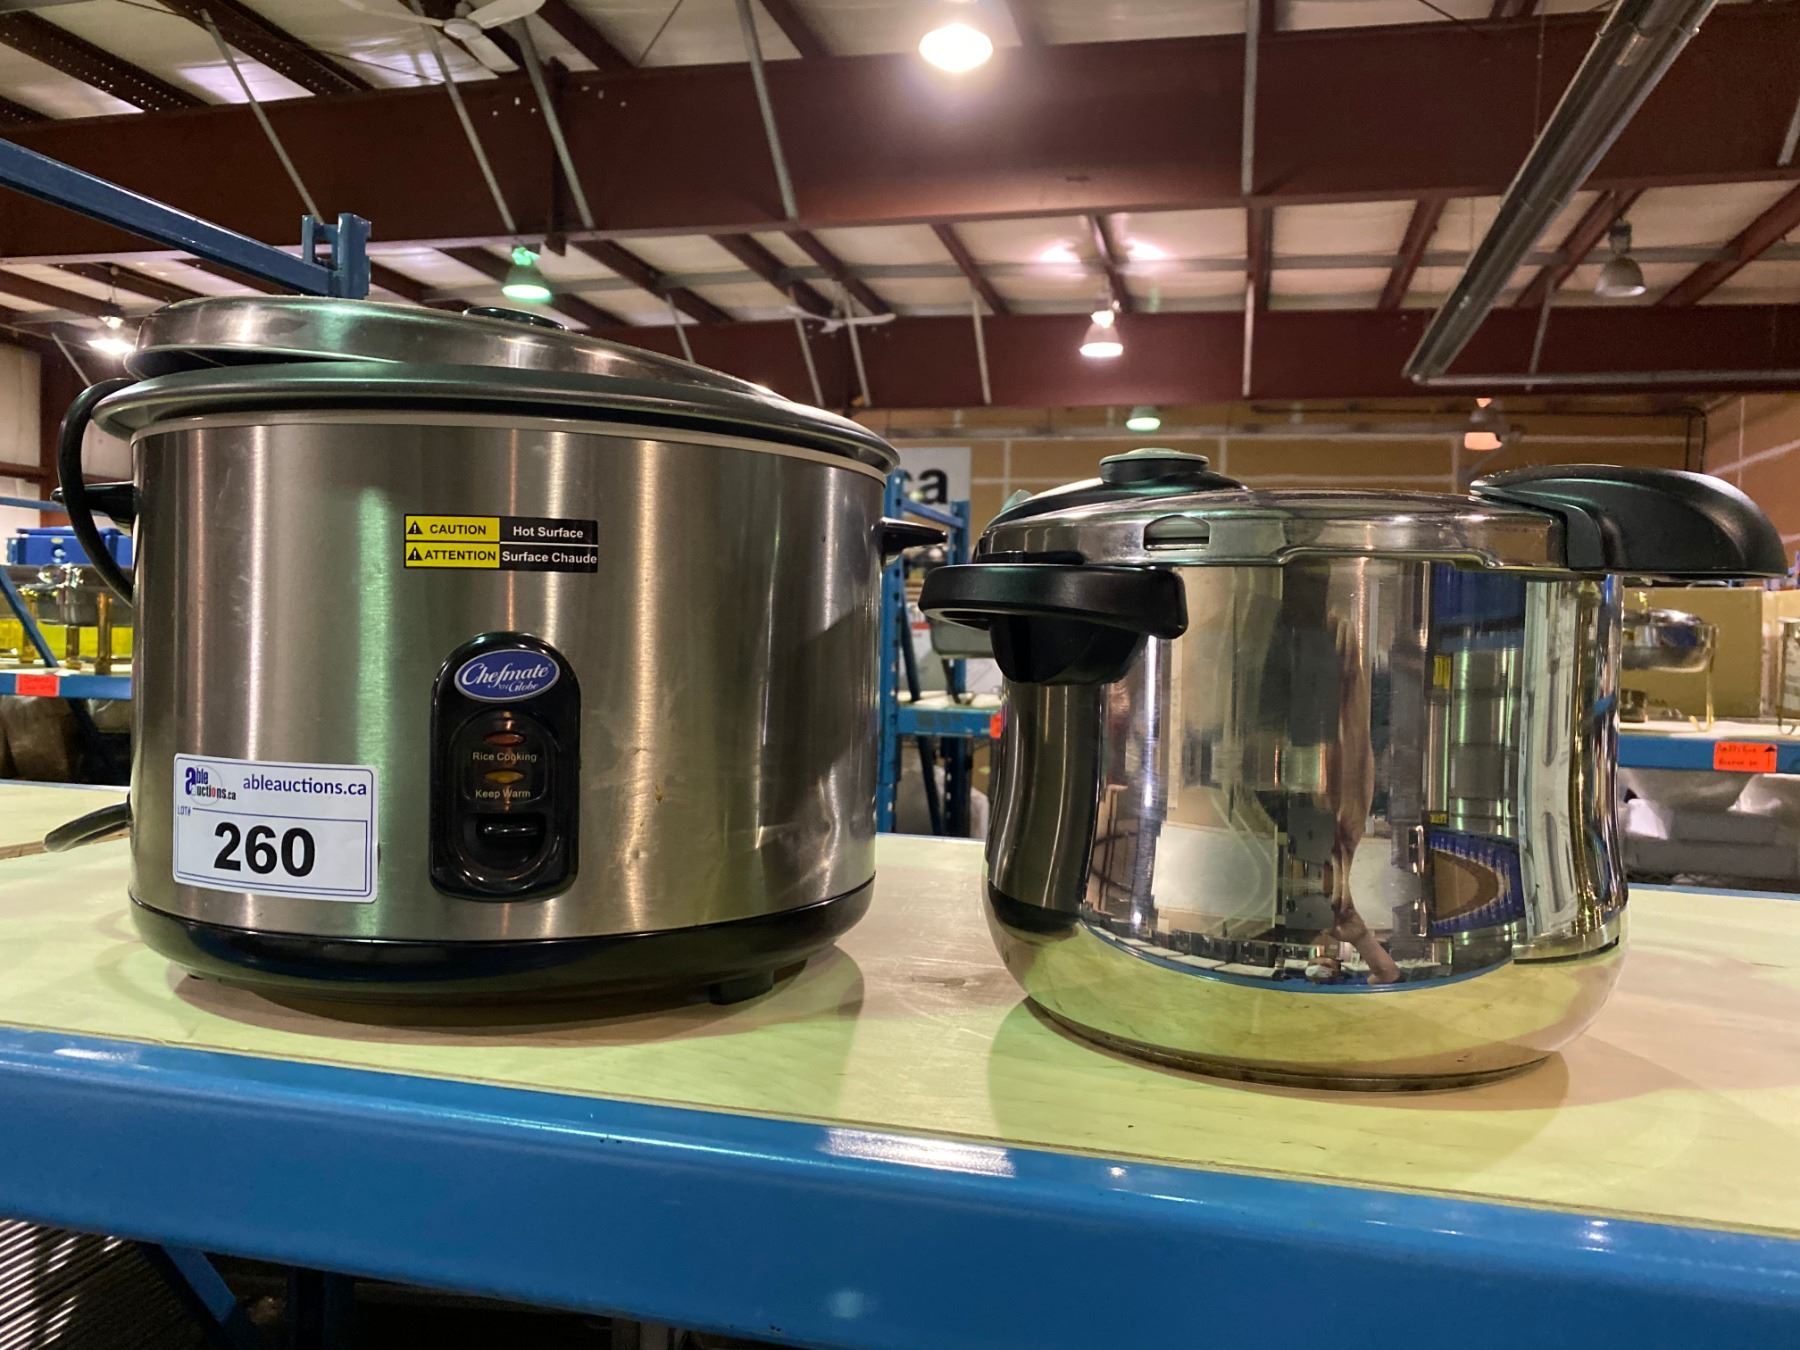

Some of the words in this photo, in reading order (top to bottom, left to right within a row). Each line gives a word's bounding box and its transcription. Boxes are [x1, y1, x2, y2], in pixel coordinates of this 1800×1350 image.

[429, 524, 487, 535] CAUTION
[513, 526, 534, 537] Hot
[537, 526, 584, 538] Surface
[424, 550, 496, 561] ATTENTION
[502, 551, 548, 563] Surface
[551, 551, 597, 564] Chaude
[461, 662, 550, 688] Chefmate
[472, 752, 495, 761] Rice
[497, 752, 537, 763] Cooking
[243, 774, 367, 796] ableauctions.ca
[475, 789, 500, 799] Keep
[503, 789, 531, 798] Warm
[213, 821, 316, 877] 260
